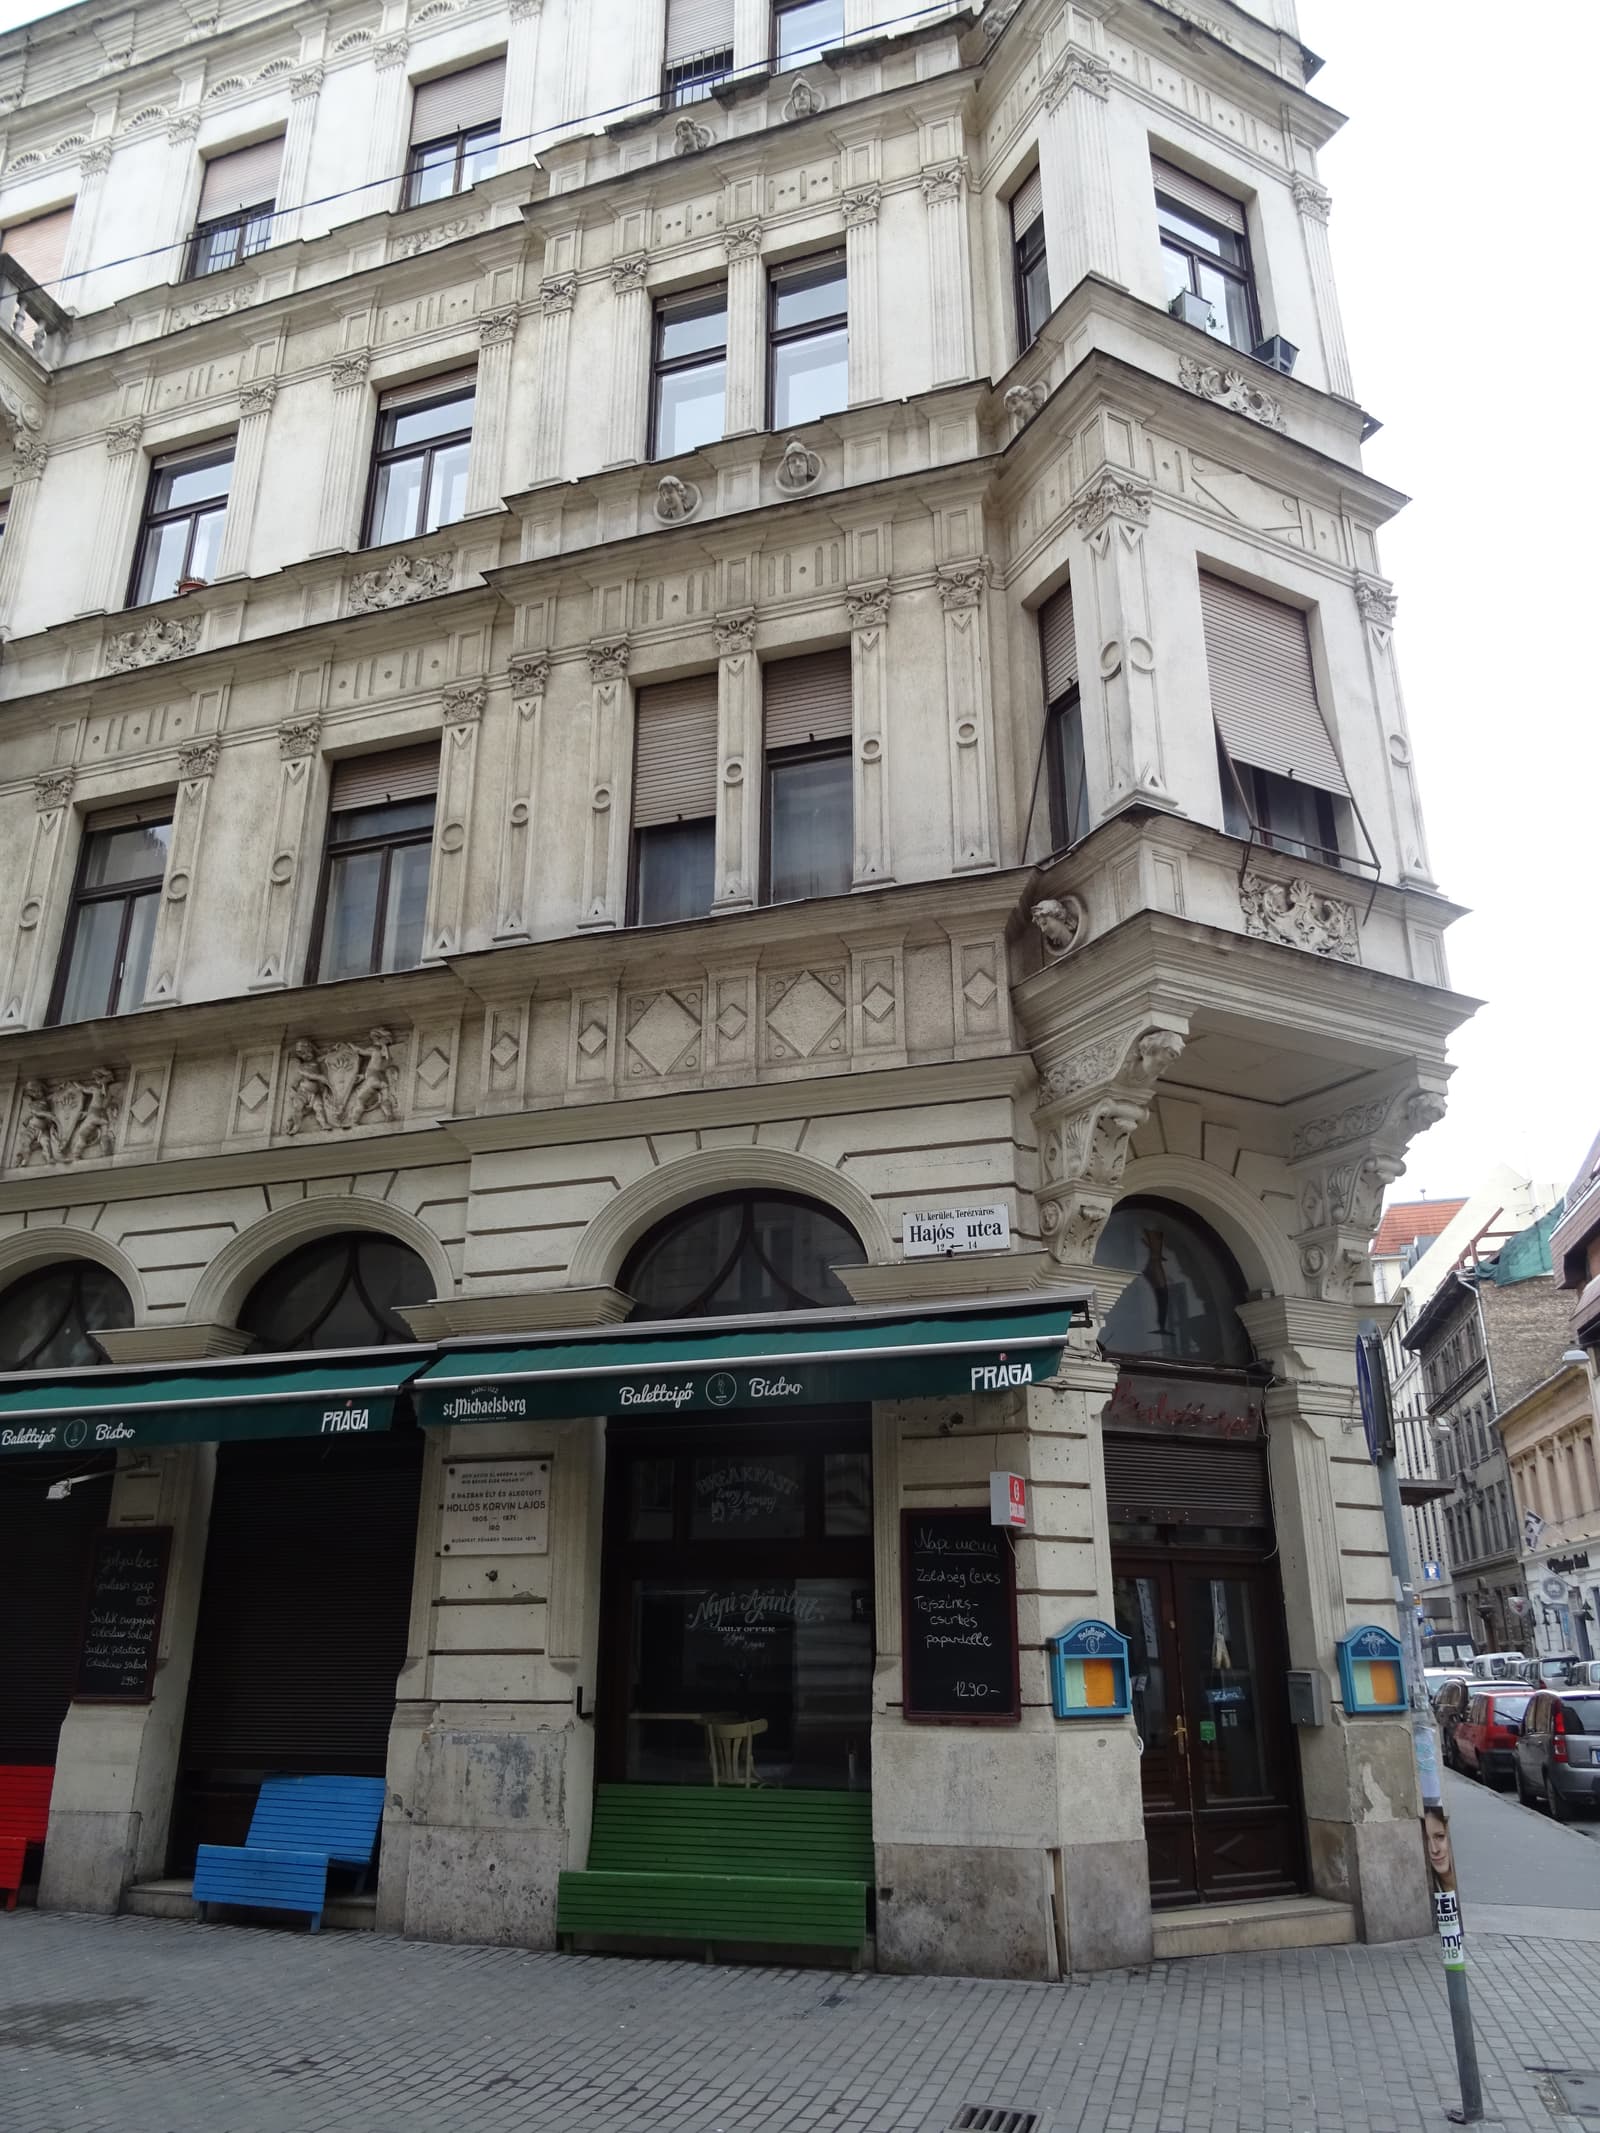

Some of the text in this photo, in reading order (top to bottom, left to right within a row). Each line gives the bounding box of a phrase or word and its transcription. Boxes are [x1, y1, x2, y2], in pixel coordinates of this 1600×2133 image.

[915, 1213, 925, 1222] VI.
[955, 1207, 995, 1219] Terézváros
[909, 1220, 1003, 1245] Hajós utca
[936, 1241, 978, 1252] 12 14
[971, 1363, 1033, 1391] PRAGA
[619, 1376, 803, 1408] Balettcipő Bistro
[321, 1409, 369, 1433] PRAGA
[1, 1422, 136, 1449] Balettcipő Bistro
[518, 1500, 546, 1511] LAJOS
[718, 1625, 776, 1633] DAILY OFFER
